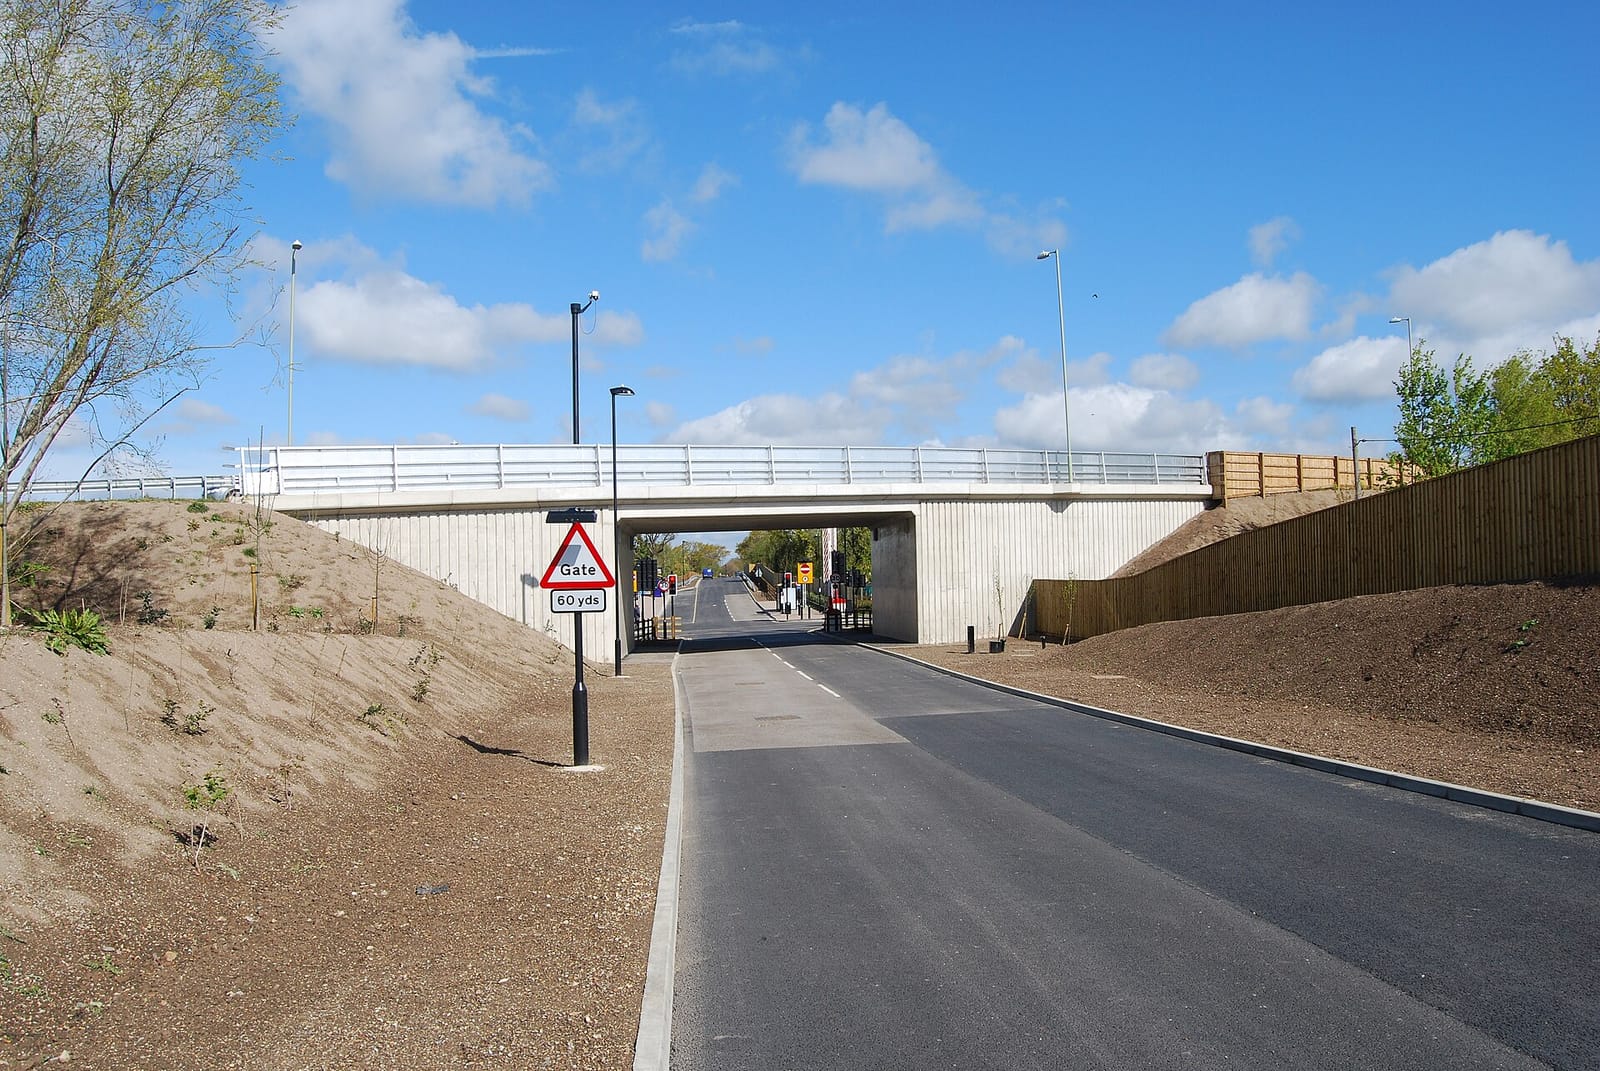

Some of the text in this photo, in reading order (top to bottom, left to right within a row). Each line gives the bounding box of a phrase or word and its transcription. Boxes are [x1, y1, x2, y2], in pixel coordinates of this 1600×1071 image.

[560, 564, 596, 576] Gate
[557, 595, 599, 607] 60 yds
